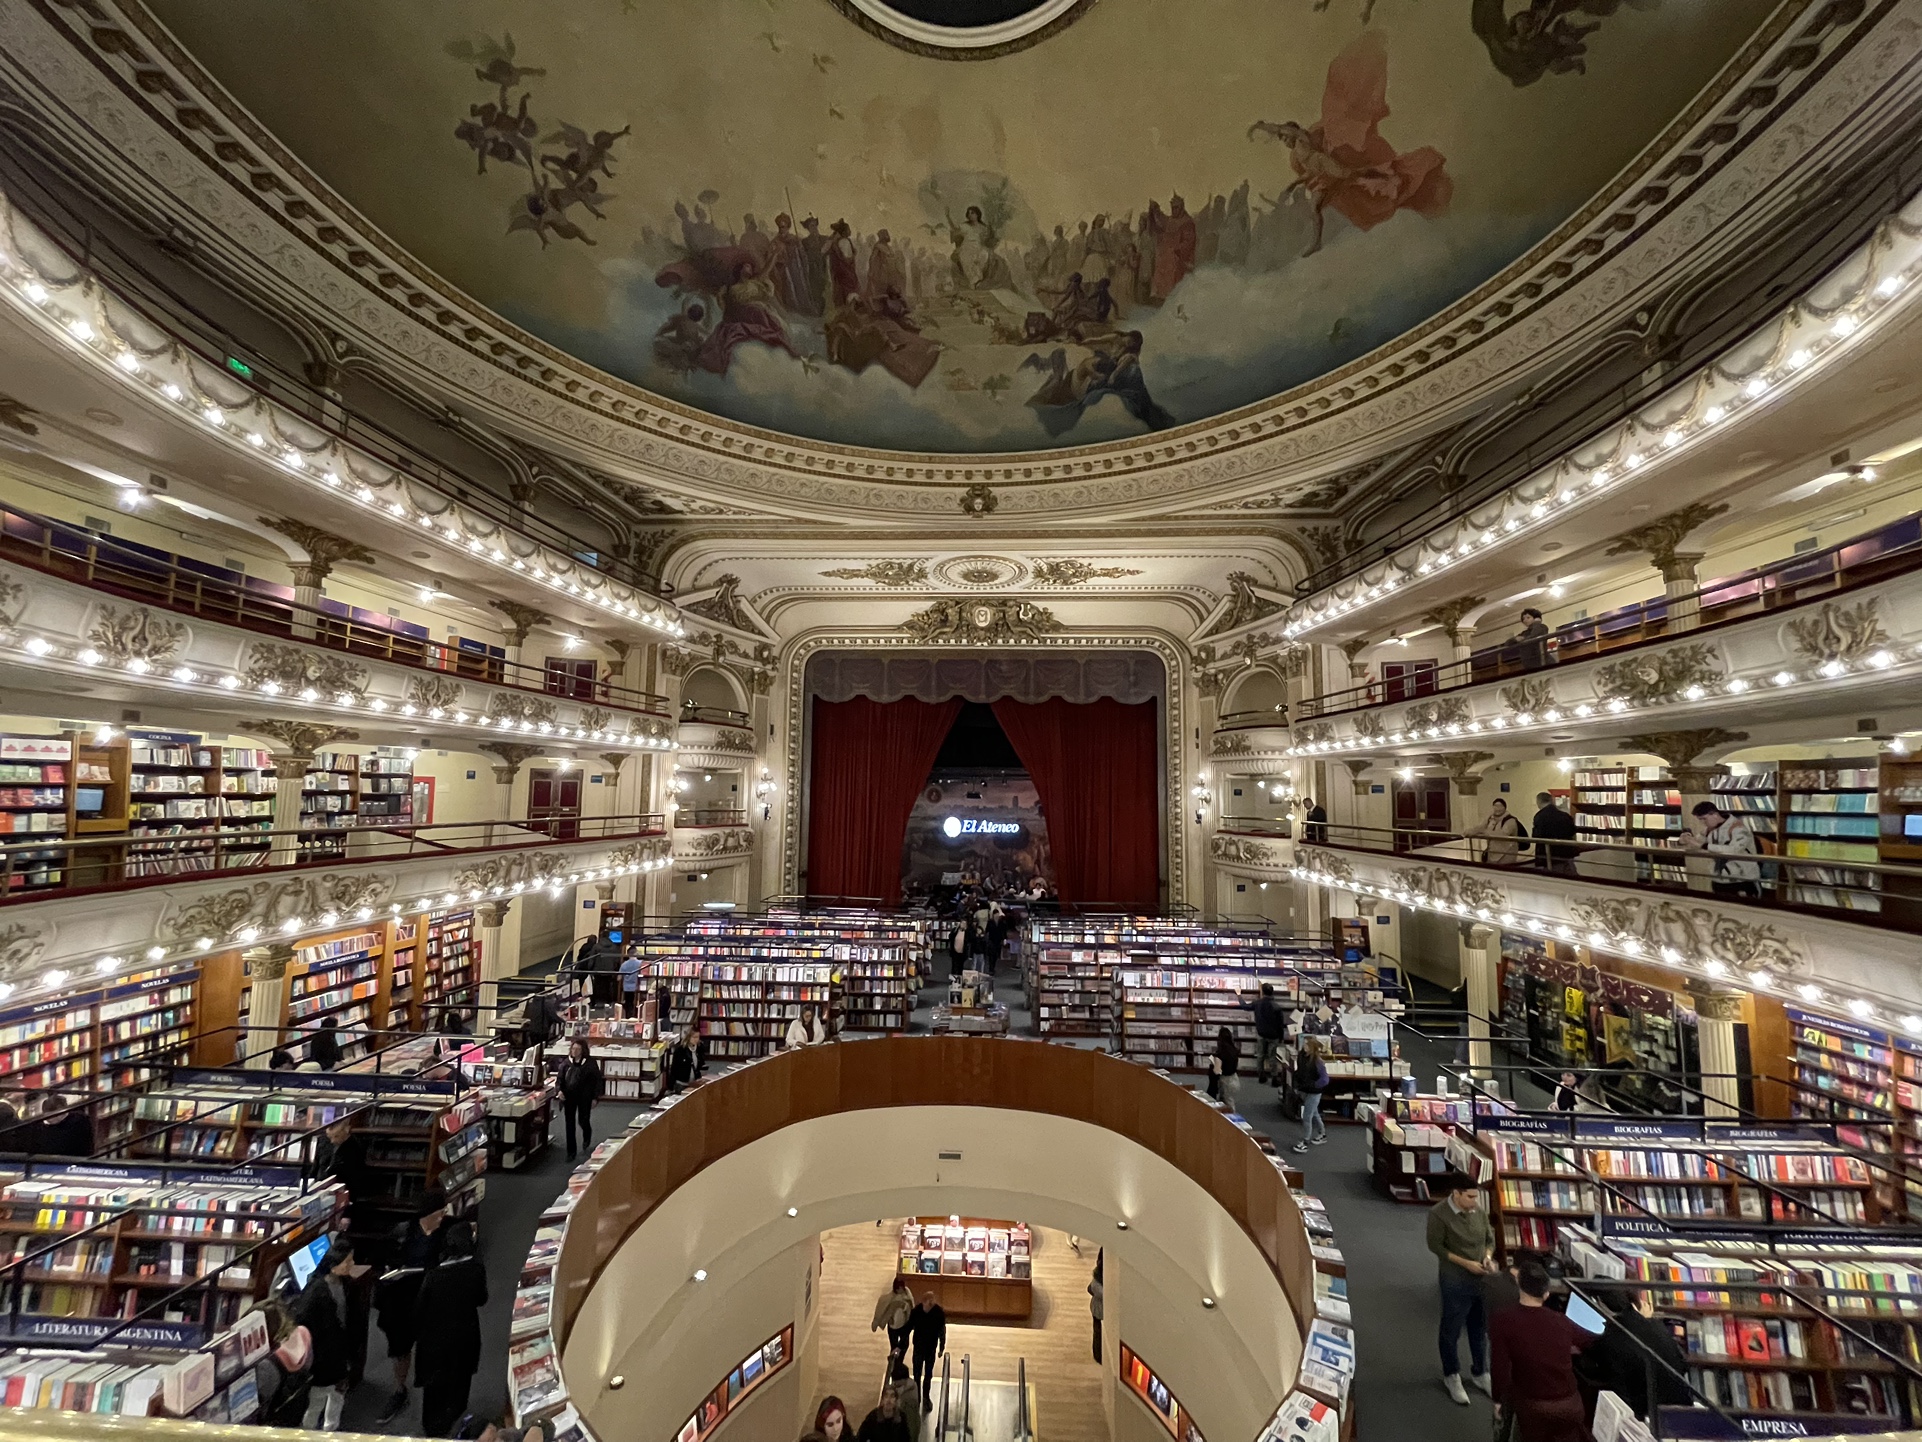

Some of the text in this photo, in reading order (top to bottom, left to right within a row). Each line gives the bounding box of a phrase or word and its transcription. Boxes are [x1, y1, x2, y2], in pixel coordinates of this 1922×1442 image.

[961, 819, 1020, 833] El Ateneo
[141, 978, 170, 989] NOVELAS
[33, 1000, 68, 1013] NOVELAS
[1499, 1119, 1548, 1129] BIOGRAFÍAS
[34, 1322, 182, 1341] LITERATURA RGENTINA
[1741, 1418, 1808, 1435] EMPRESA
